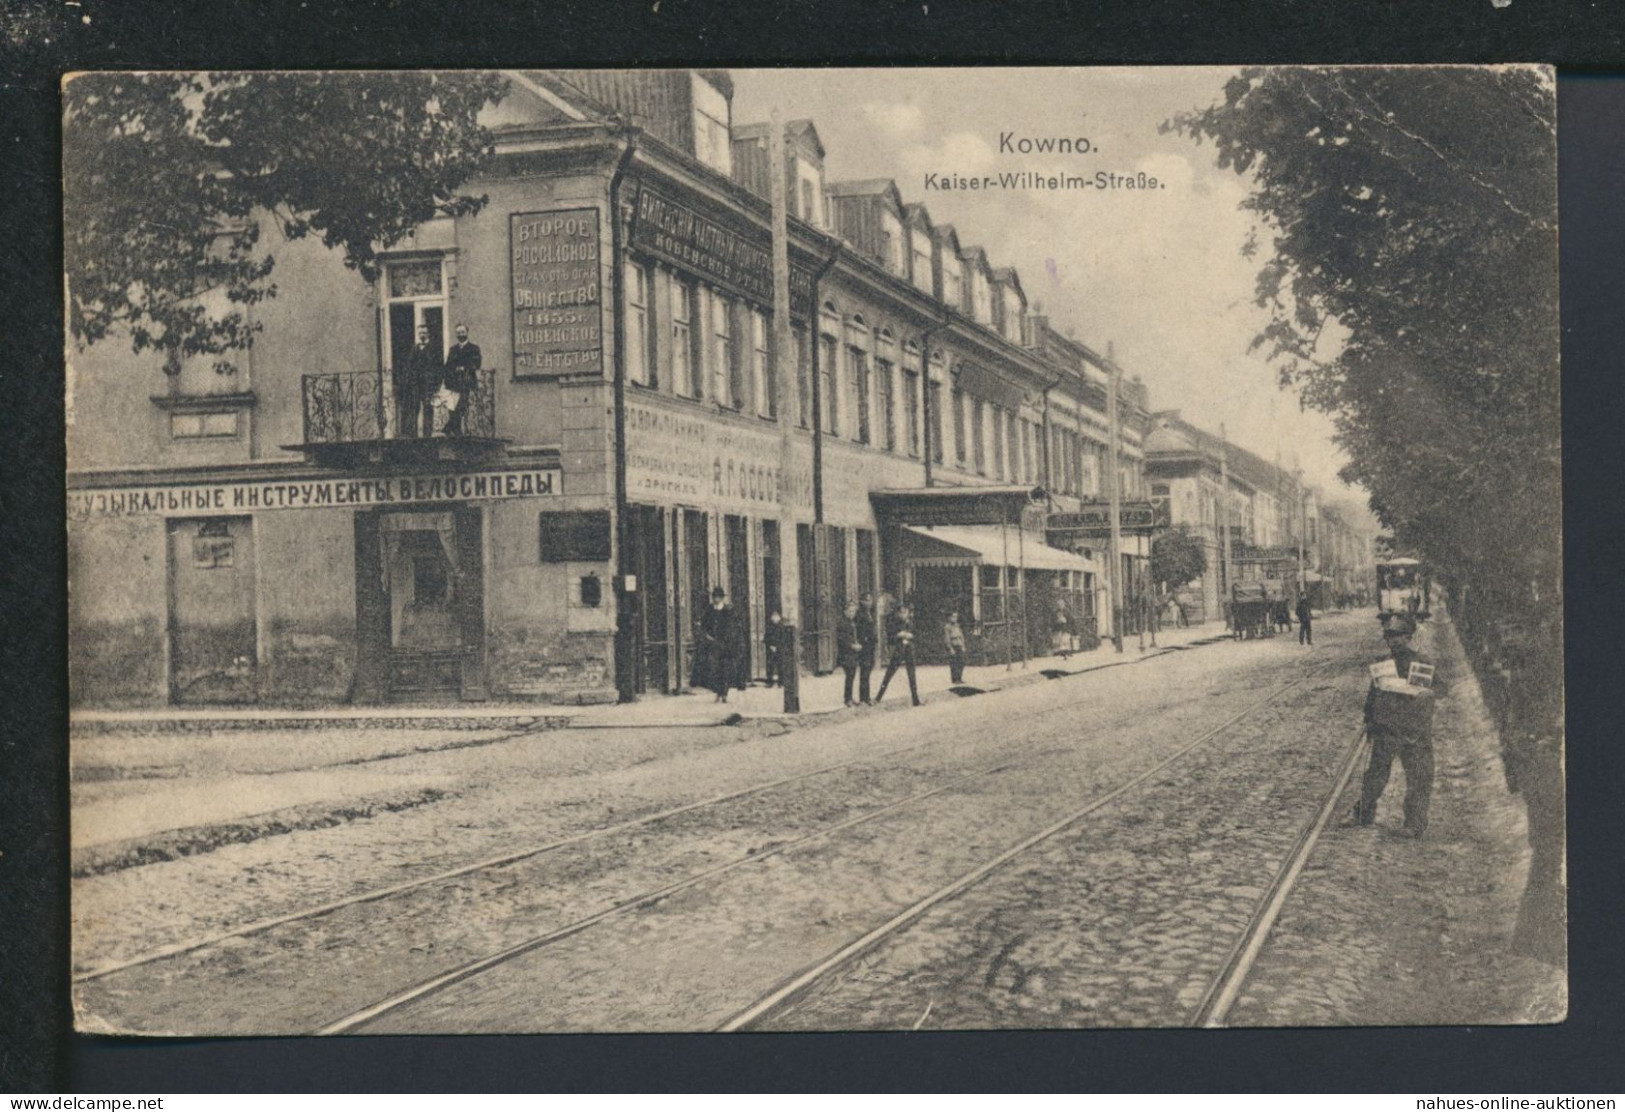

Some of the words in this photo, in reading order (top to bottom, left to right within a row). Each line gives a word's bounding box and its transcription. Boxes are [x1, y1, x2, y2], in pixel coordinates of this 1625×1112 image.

[519, 218, 590, 242] ВТОРОЕ
[515, 283, 597, 310] ОБЩЕСТВО
[516, 326, 598, 345] КОВЕНСКОЕ
[68, 488, 225, 516] УЗЫКАЛЬНЫЕ
[400, 472, 553, 500] ВЕЛОСИПЕДЫ
